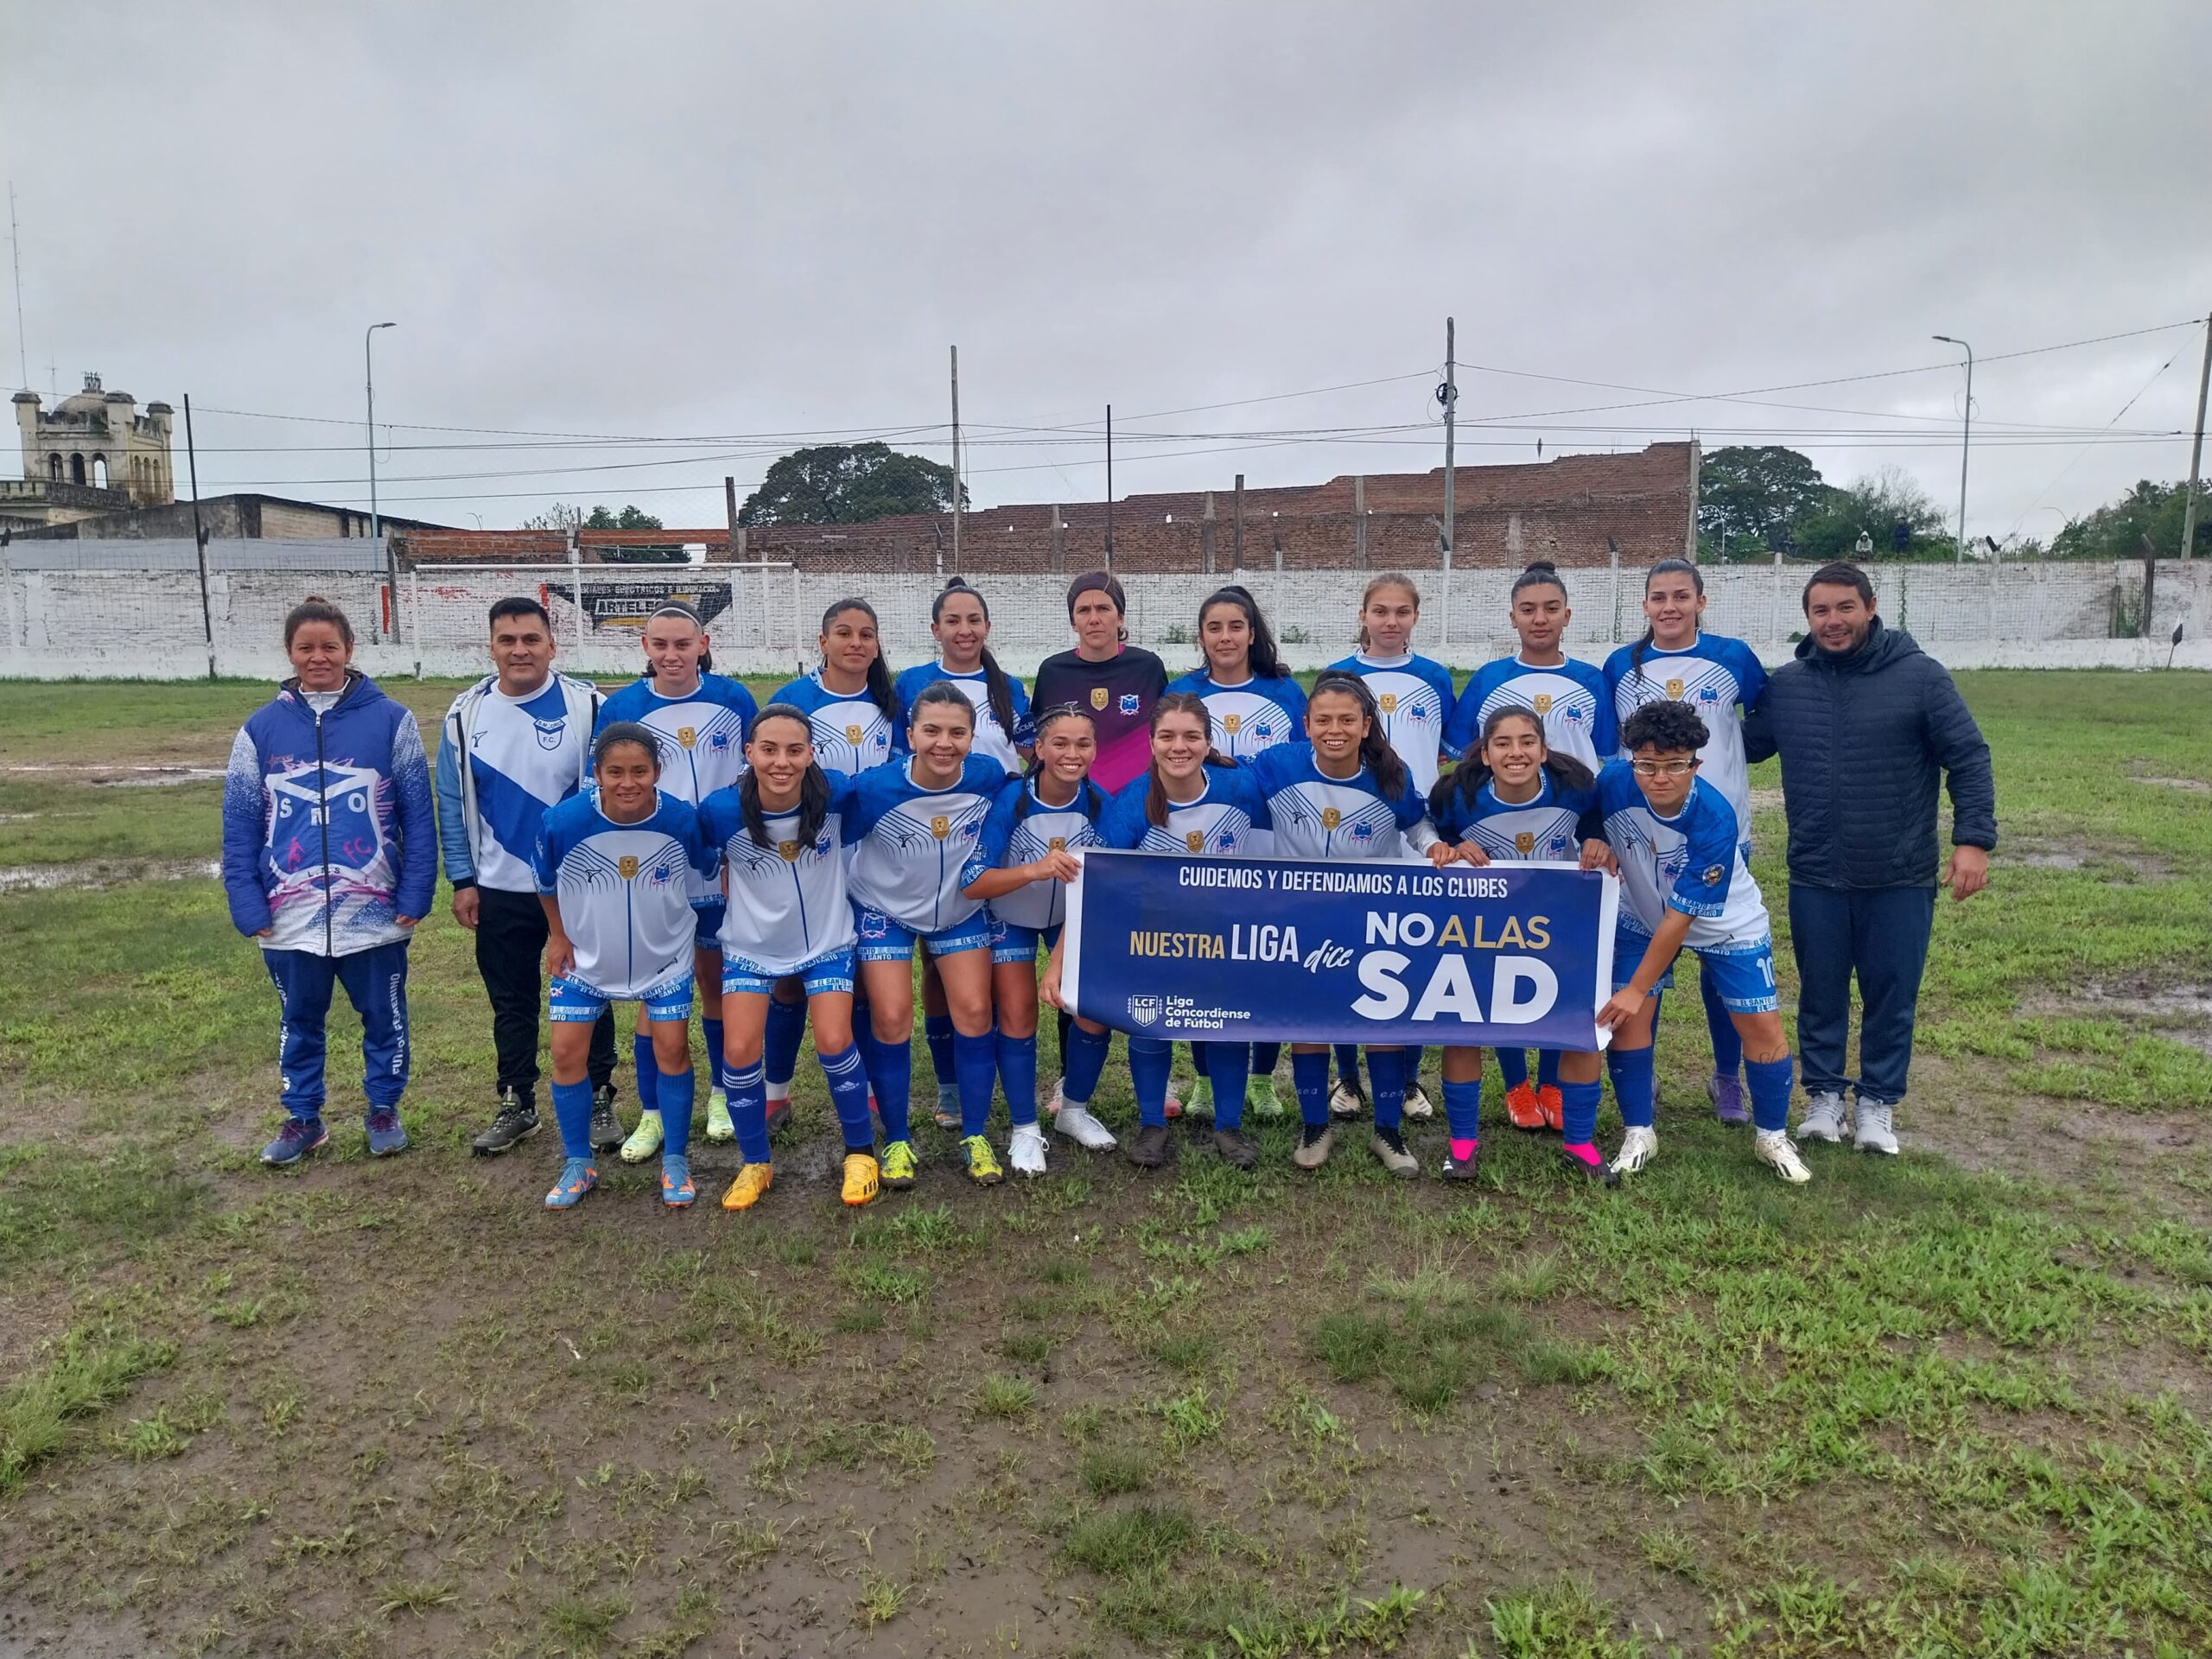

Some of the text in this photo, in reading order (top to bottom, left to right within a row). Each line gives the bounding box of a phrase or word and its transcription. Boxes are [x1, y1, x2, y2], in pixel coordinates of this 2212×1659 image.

[1179, 866, 1508, 899] CUIDEMOS Y DEFENDAMOS A LOS CLUBES
[1129, 924, 1354, 974] NUESTRA LIGA dice
[1350, 950, 1559, 1025] SAD
[1135, 998, 1155, 1007] LCF
[1166, 995, 1193, 1007] Liga
[1166, 1007, 1251, 1020] Concordiense
[1166, 1018, 1224, 1029] de Fútbol
[392, 1031, 405, 1075] FUTOL
